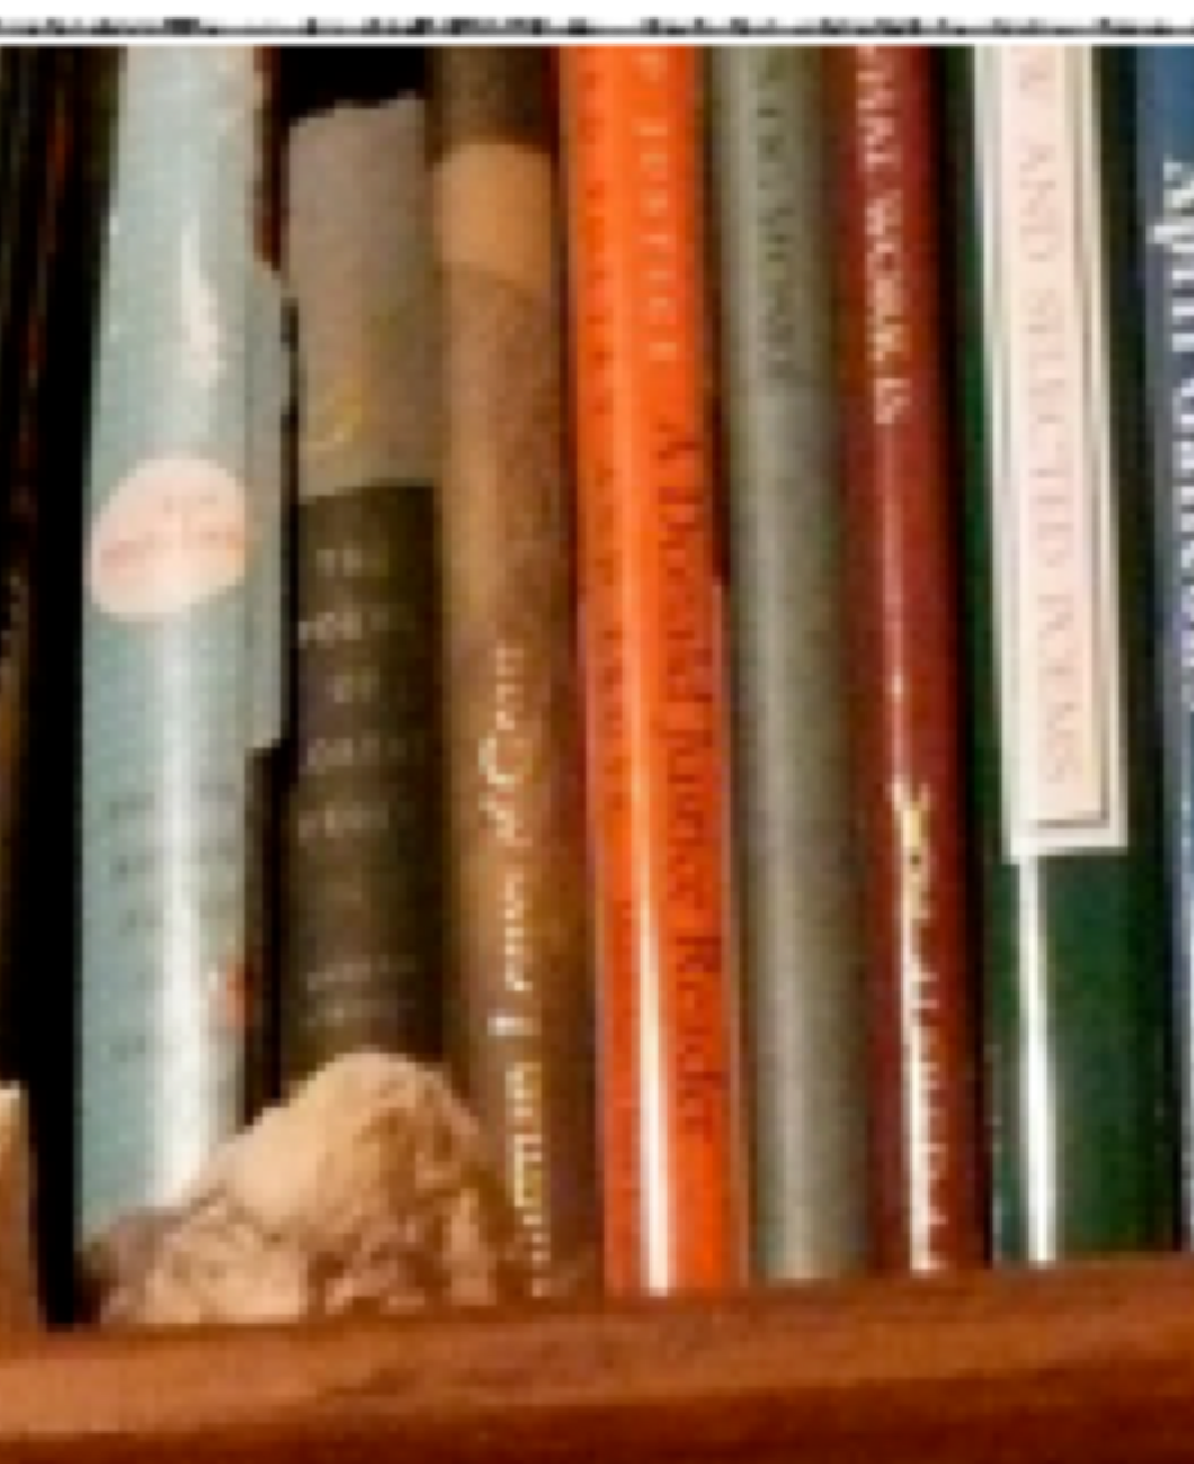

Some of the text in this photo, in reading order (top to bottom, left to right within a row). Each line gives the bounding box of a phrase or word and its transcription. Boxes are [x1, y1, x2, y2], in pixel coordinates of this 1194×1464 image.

[864, 194, 910, 348] WORK
[873, 366, 915, 425] IS
[1018, 134, 1084, 784] AND SELECTED POEMS
[657, 486, 715, 700] Donald
[650, 720, 723, 902] Justice
[670, 932, 728, 1146] Reader
